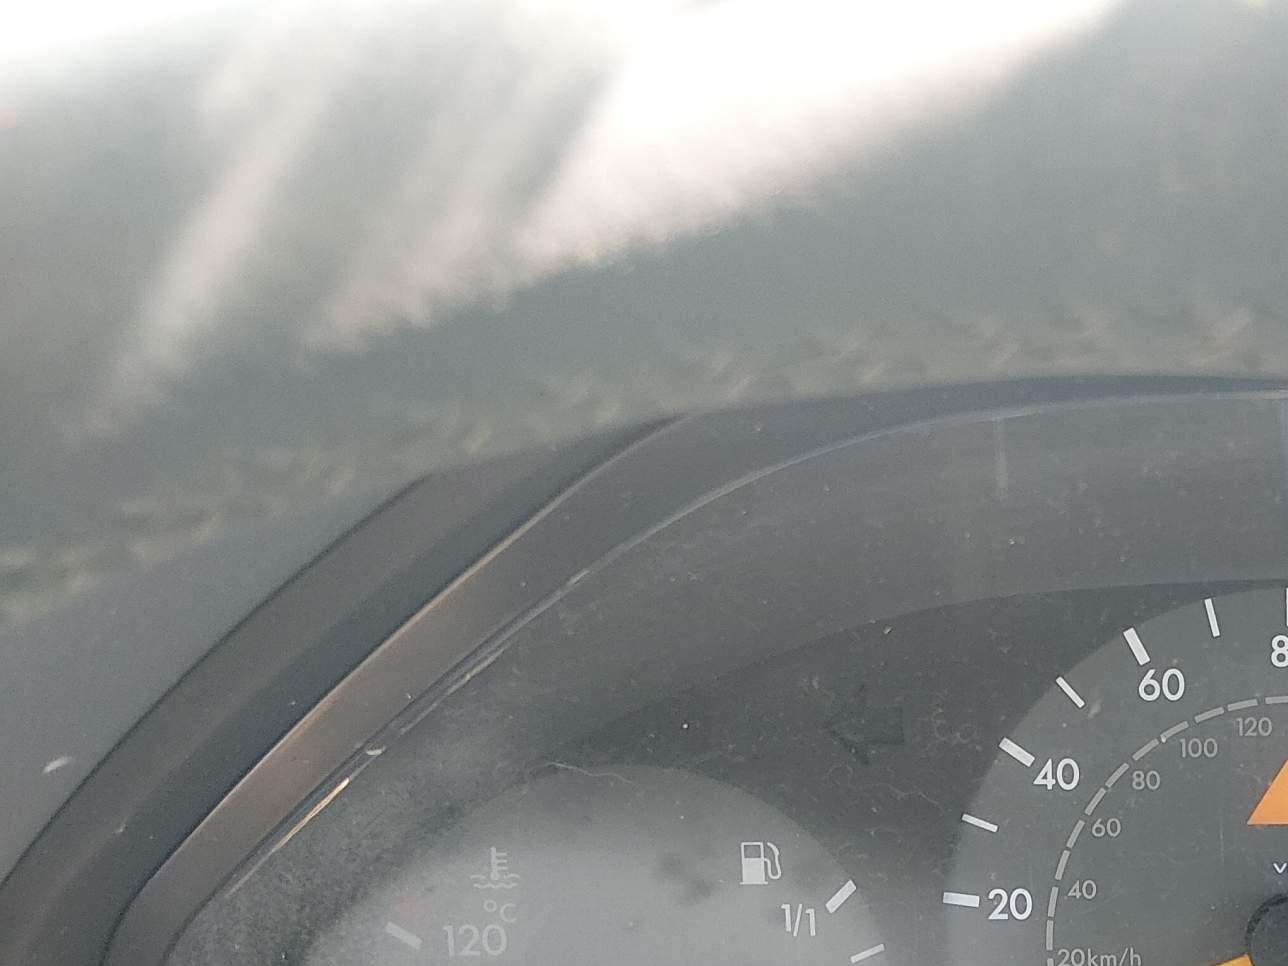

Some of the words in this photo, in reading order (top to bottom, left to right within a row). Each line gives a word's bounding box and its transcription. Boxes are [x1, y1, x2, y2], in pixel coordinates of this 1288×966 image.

[1138, 669, 1185, 700] 60
[1236, 716, 1272, 737] 120
[1180, 738, 1218, 759] 100
[1033, 759, 1079, 791] 40
[1132, 770, 1159, 790] 80
[1092, 818, 1121, 838] 60
[1068, 881, 1096, 900] 40
[988, 888, 1032, 920] 20
[782, 904, 816, 936] 1/1
[443, 926, 507, 957] 120
